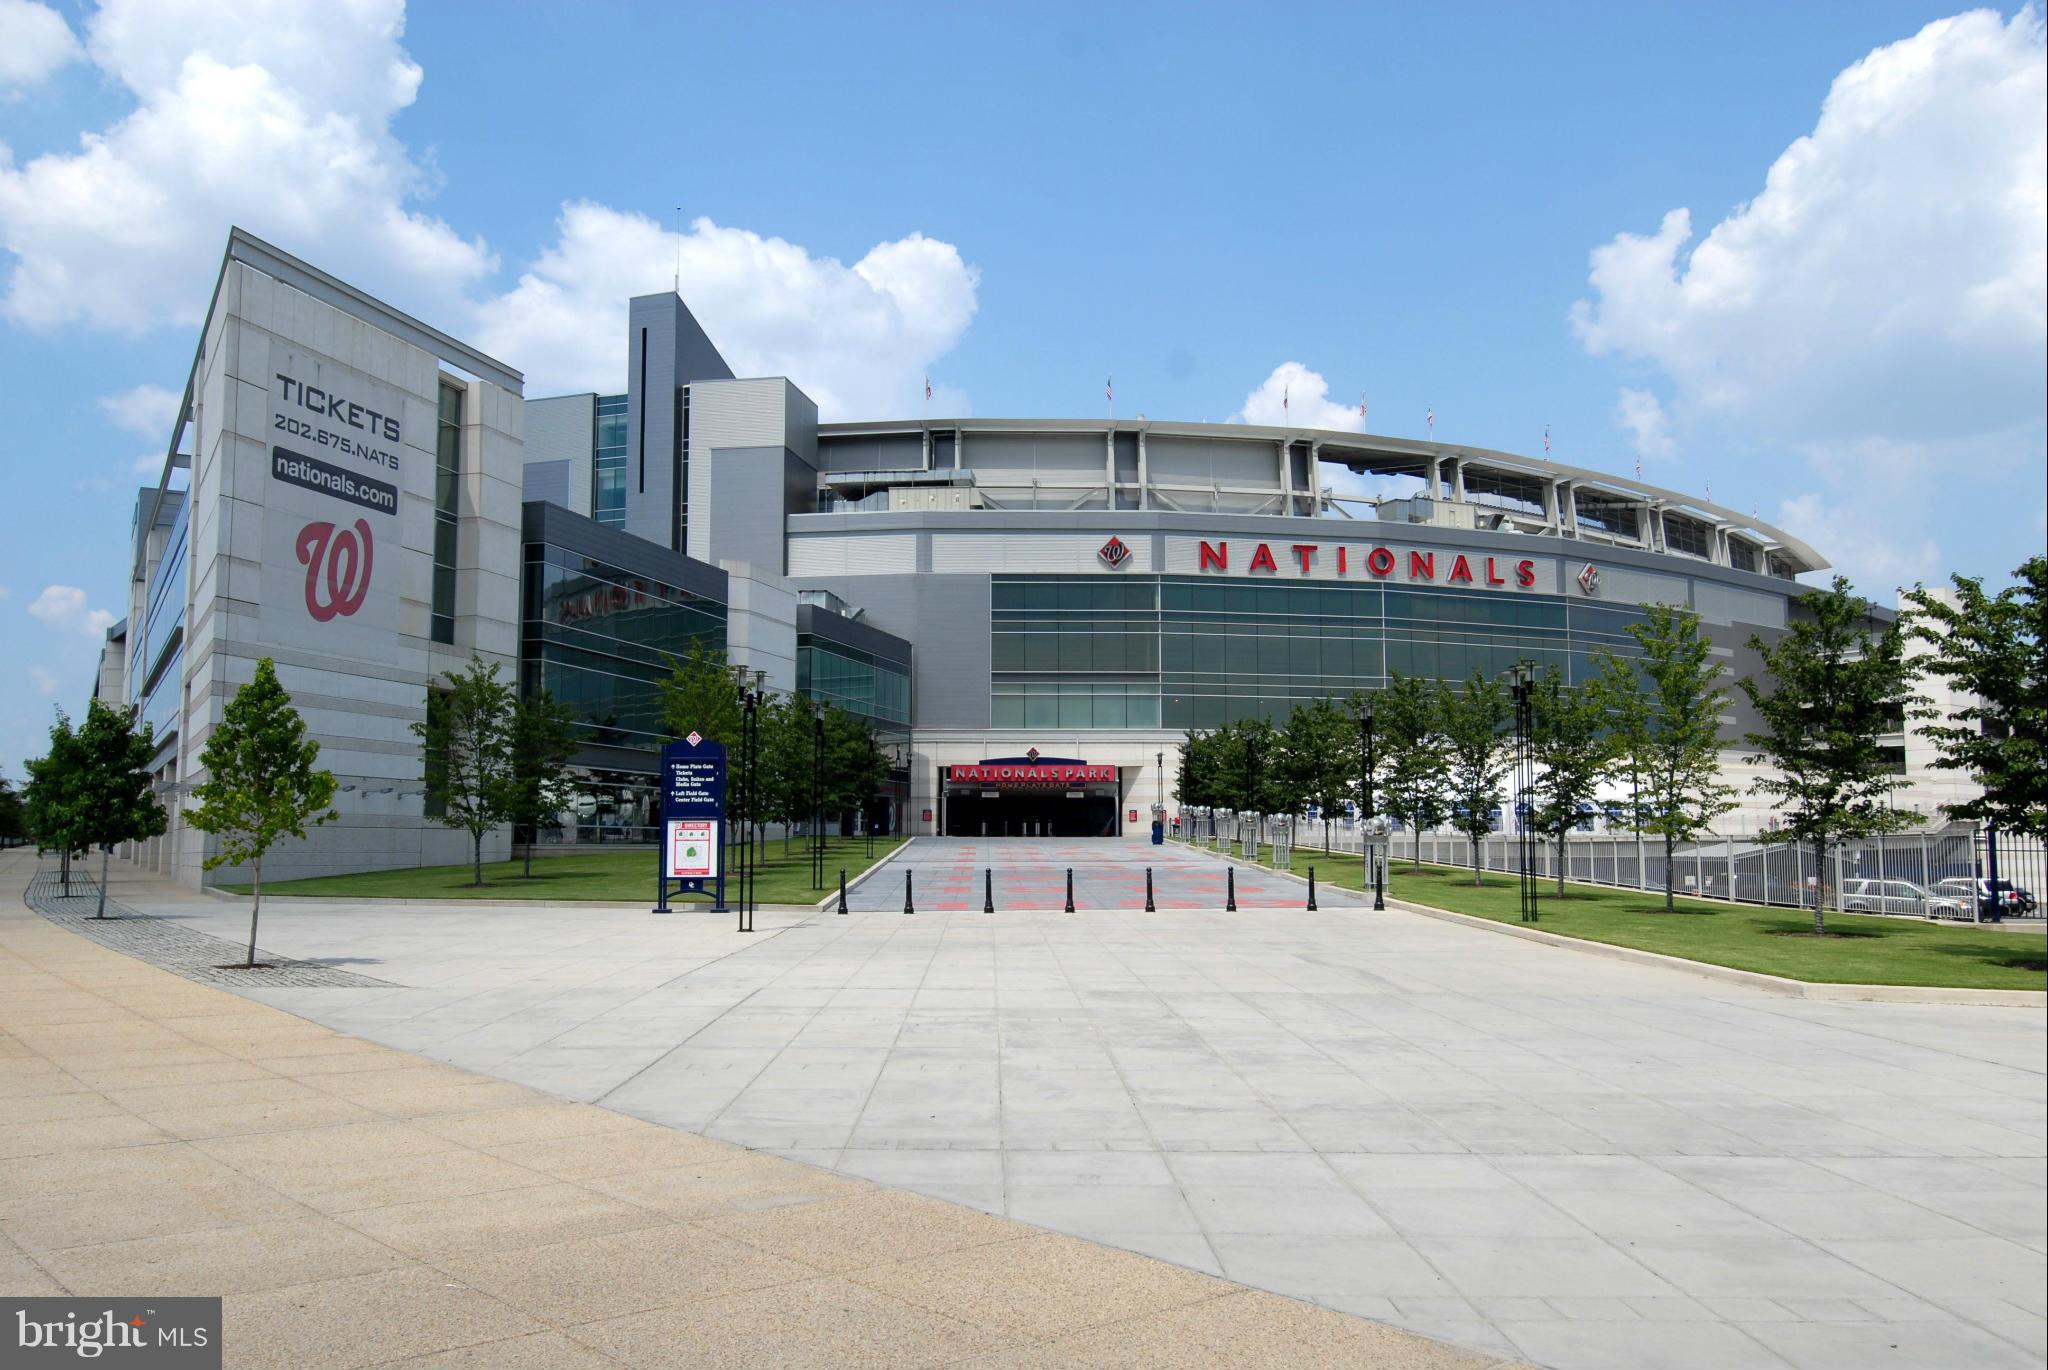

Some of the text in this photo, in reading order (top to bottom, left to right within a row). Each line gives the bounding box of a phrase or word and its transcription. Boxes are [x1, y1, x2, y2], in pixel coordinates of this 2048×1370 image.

[276, 373, 400, 443] TICKETS
[274, 413, 399, 471] 202.675.NATS
[277, 455, 394, 508] nationals.com
[295, 518, 374, 622] W
[1200, 540, 1536, 587] NATIONALS
[955, 767, 1111, 779] NATIONALS PARK
